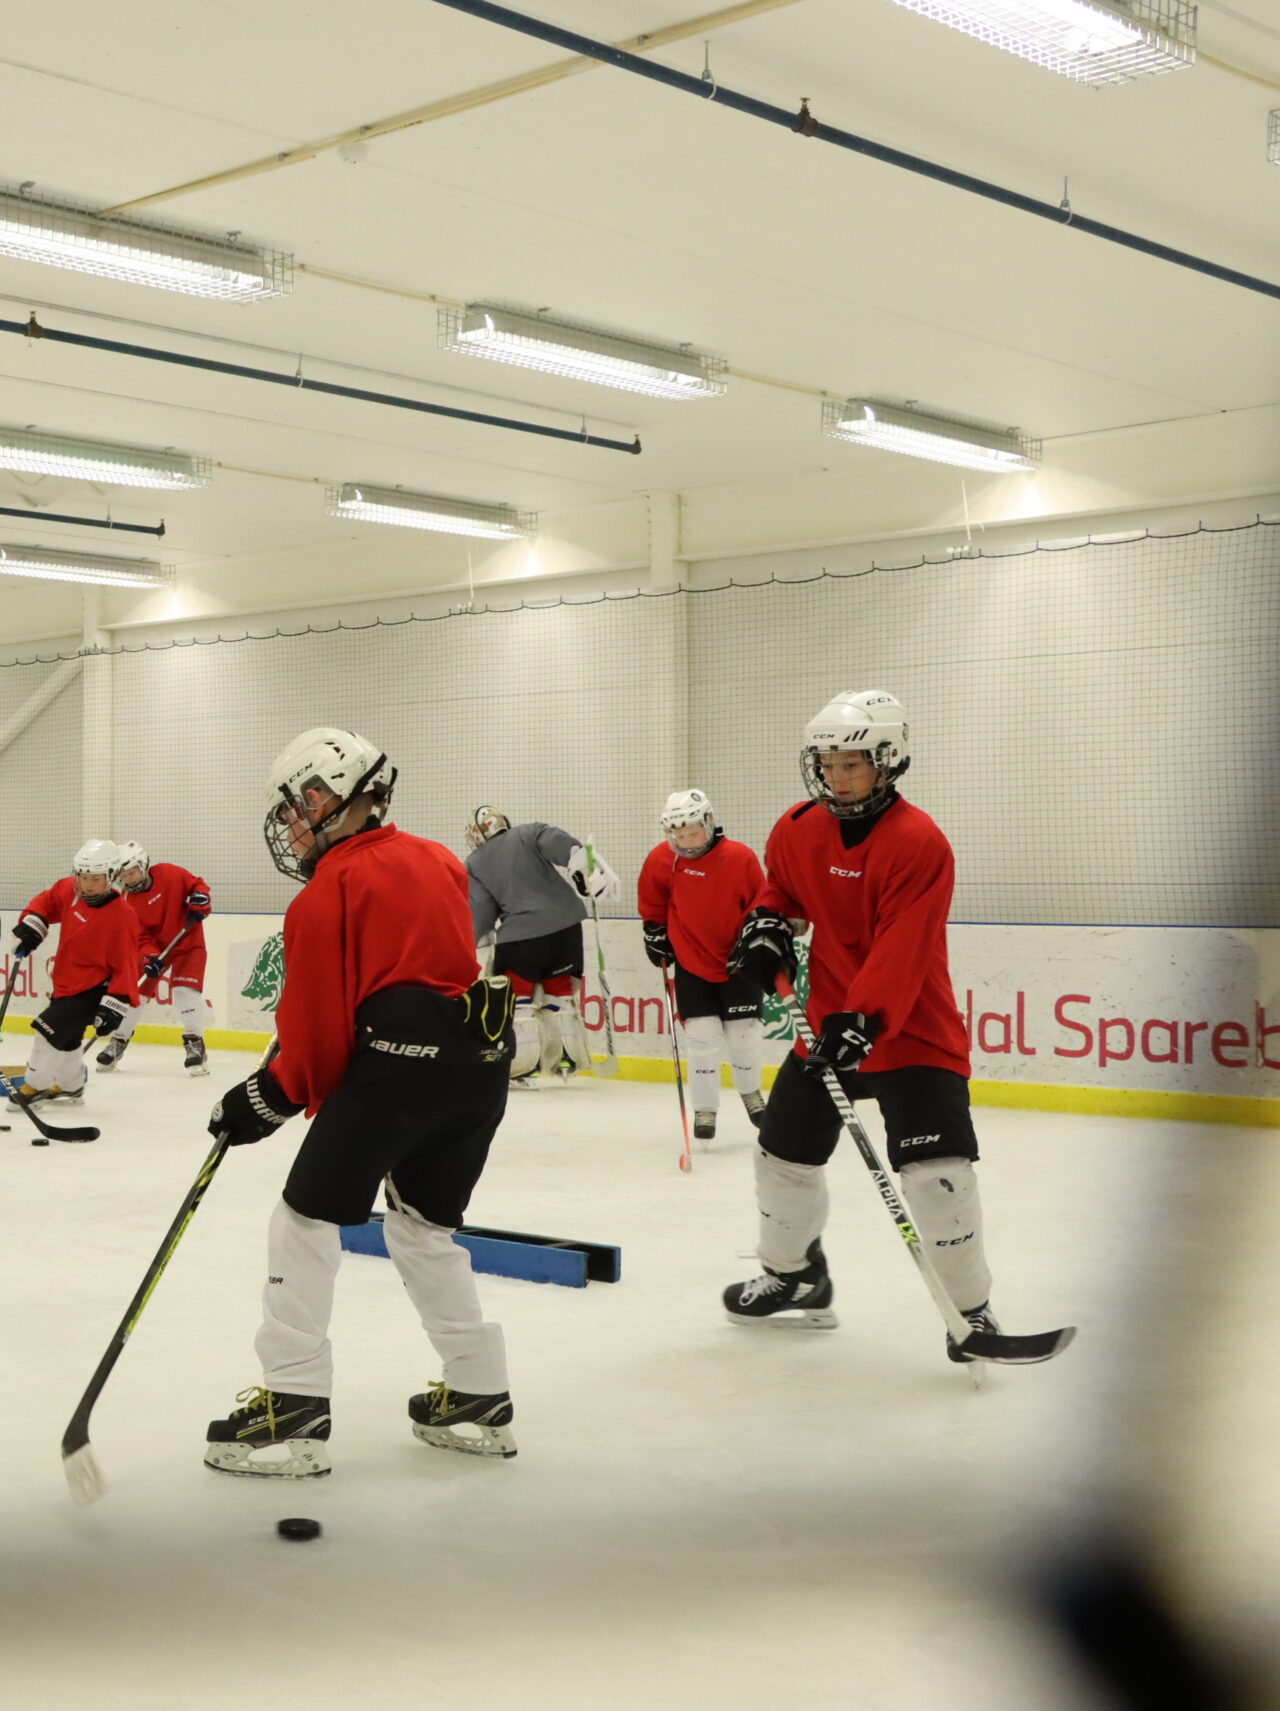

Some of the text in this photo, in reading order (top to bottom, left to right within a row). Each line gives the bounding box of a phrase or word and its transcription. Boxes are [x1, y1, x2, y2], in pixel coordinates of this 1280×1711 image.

[289, 762, 313, 784] CCM
[683, 868, 706, 877] CCM
[830, 866, 863, 879] CCM
[728, 1004, 757, 1013] CCM
[899, 1134, 941, 1148] CCM
[935, 1231, 975, 1247] CCM
